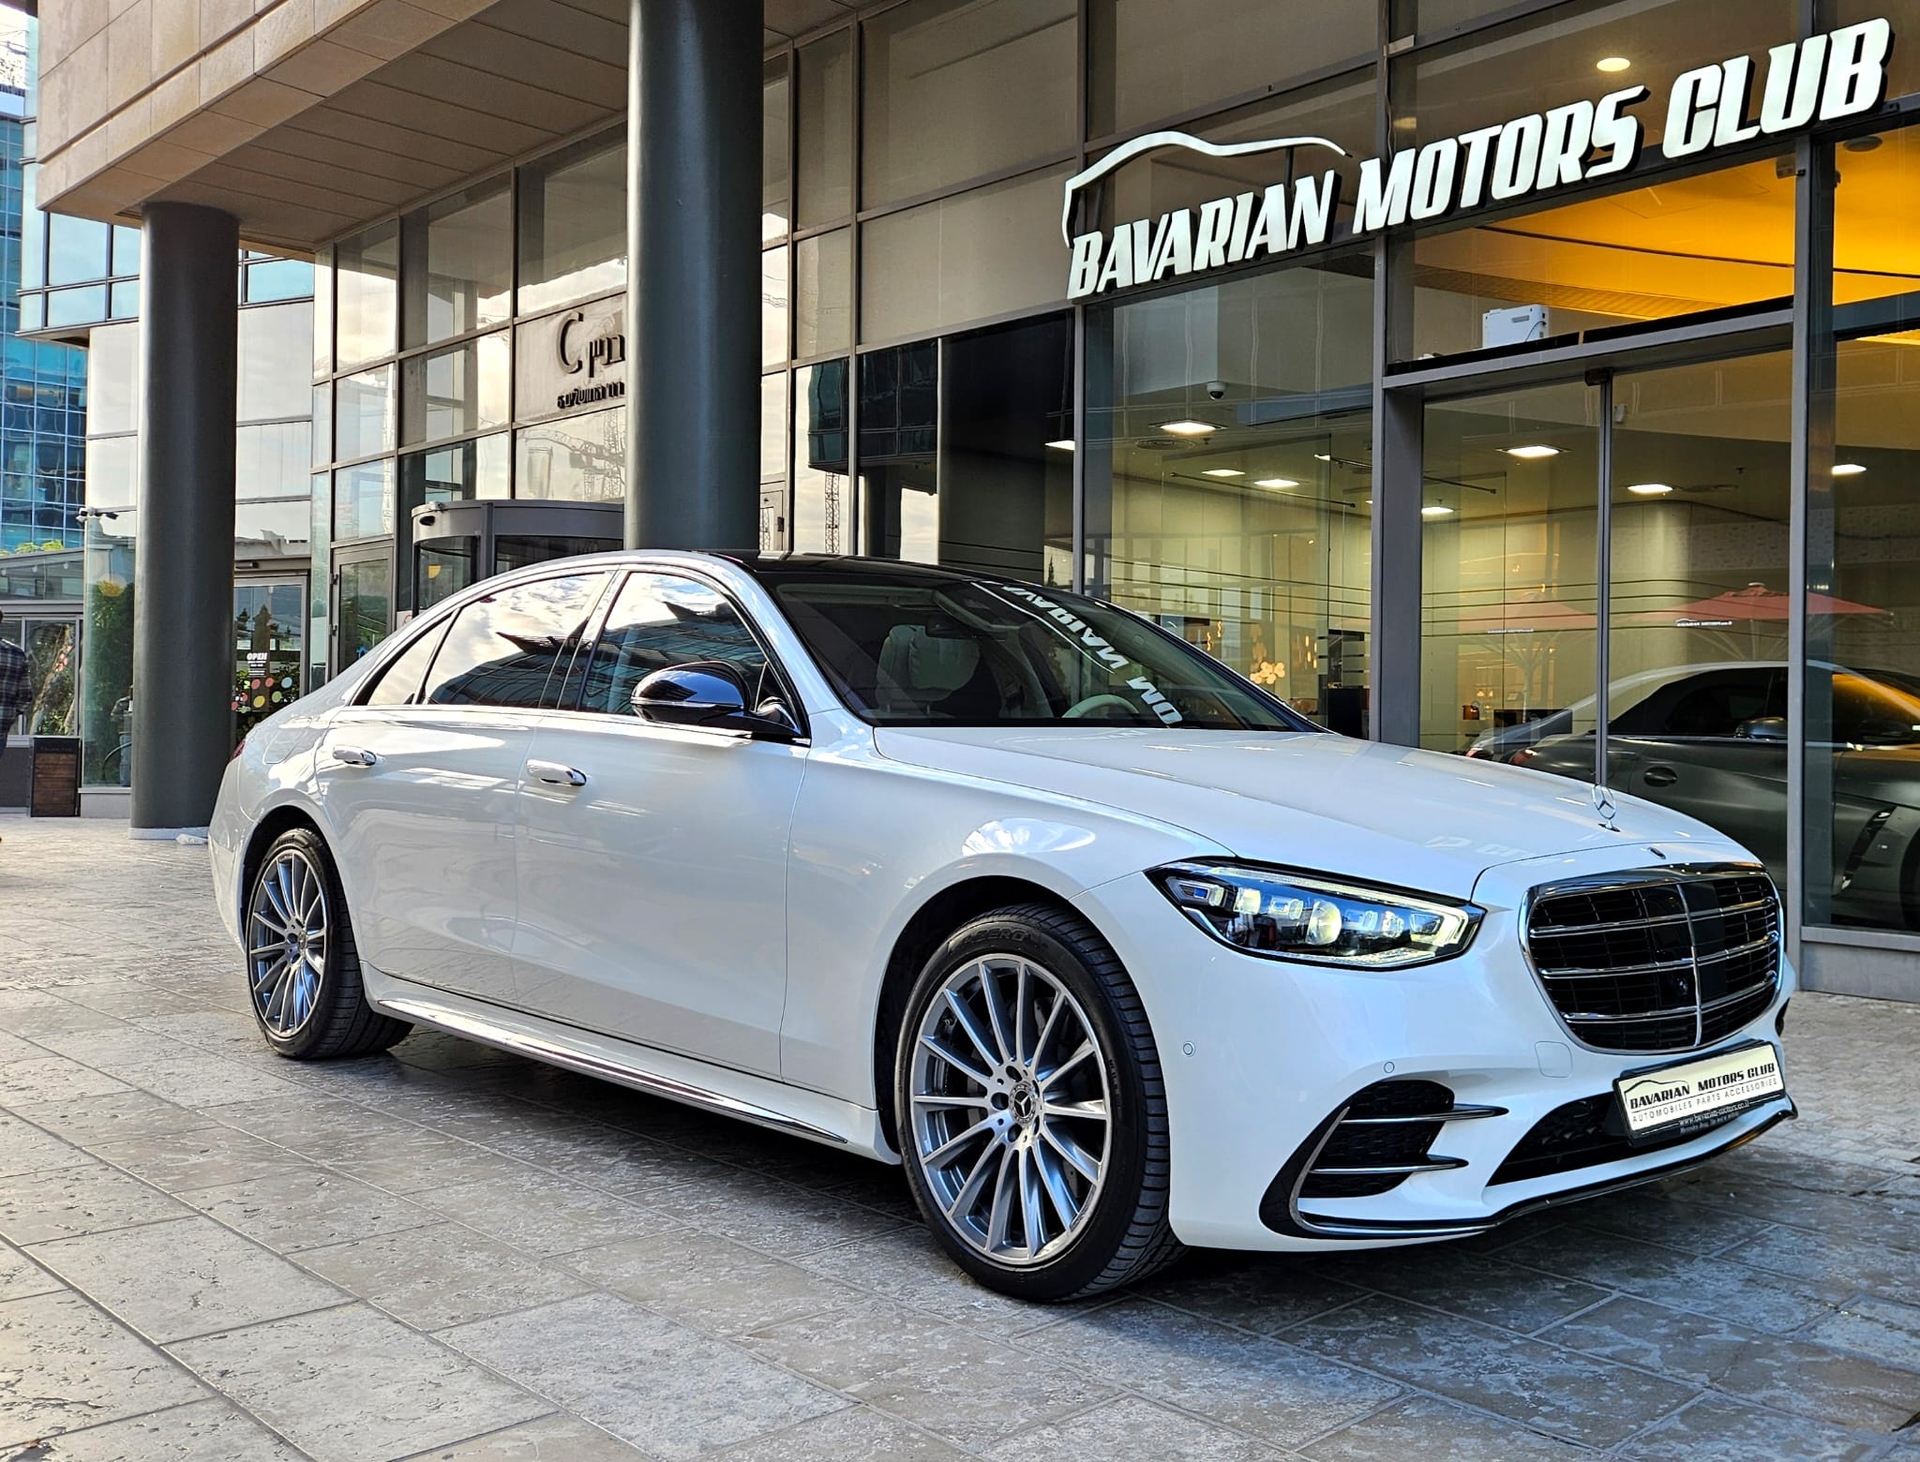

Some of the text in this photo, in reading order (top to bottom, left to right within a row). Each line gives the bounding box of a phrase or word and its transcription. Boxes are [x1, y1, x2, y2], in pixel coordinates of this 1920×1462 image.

[1067, 17, 1892, 300] BAVARIAN MOTORS CLUB
[1630, 1062, 1775, 1110] BAVARIAN MOTORS CLUB
[1632, 1077, 1778, 1122] AUTOMOBILES PARTS ACCESSORIES
